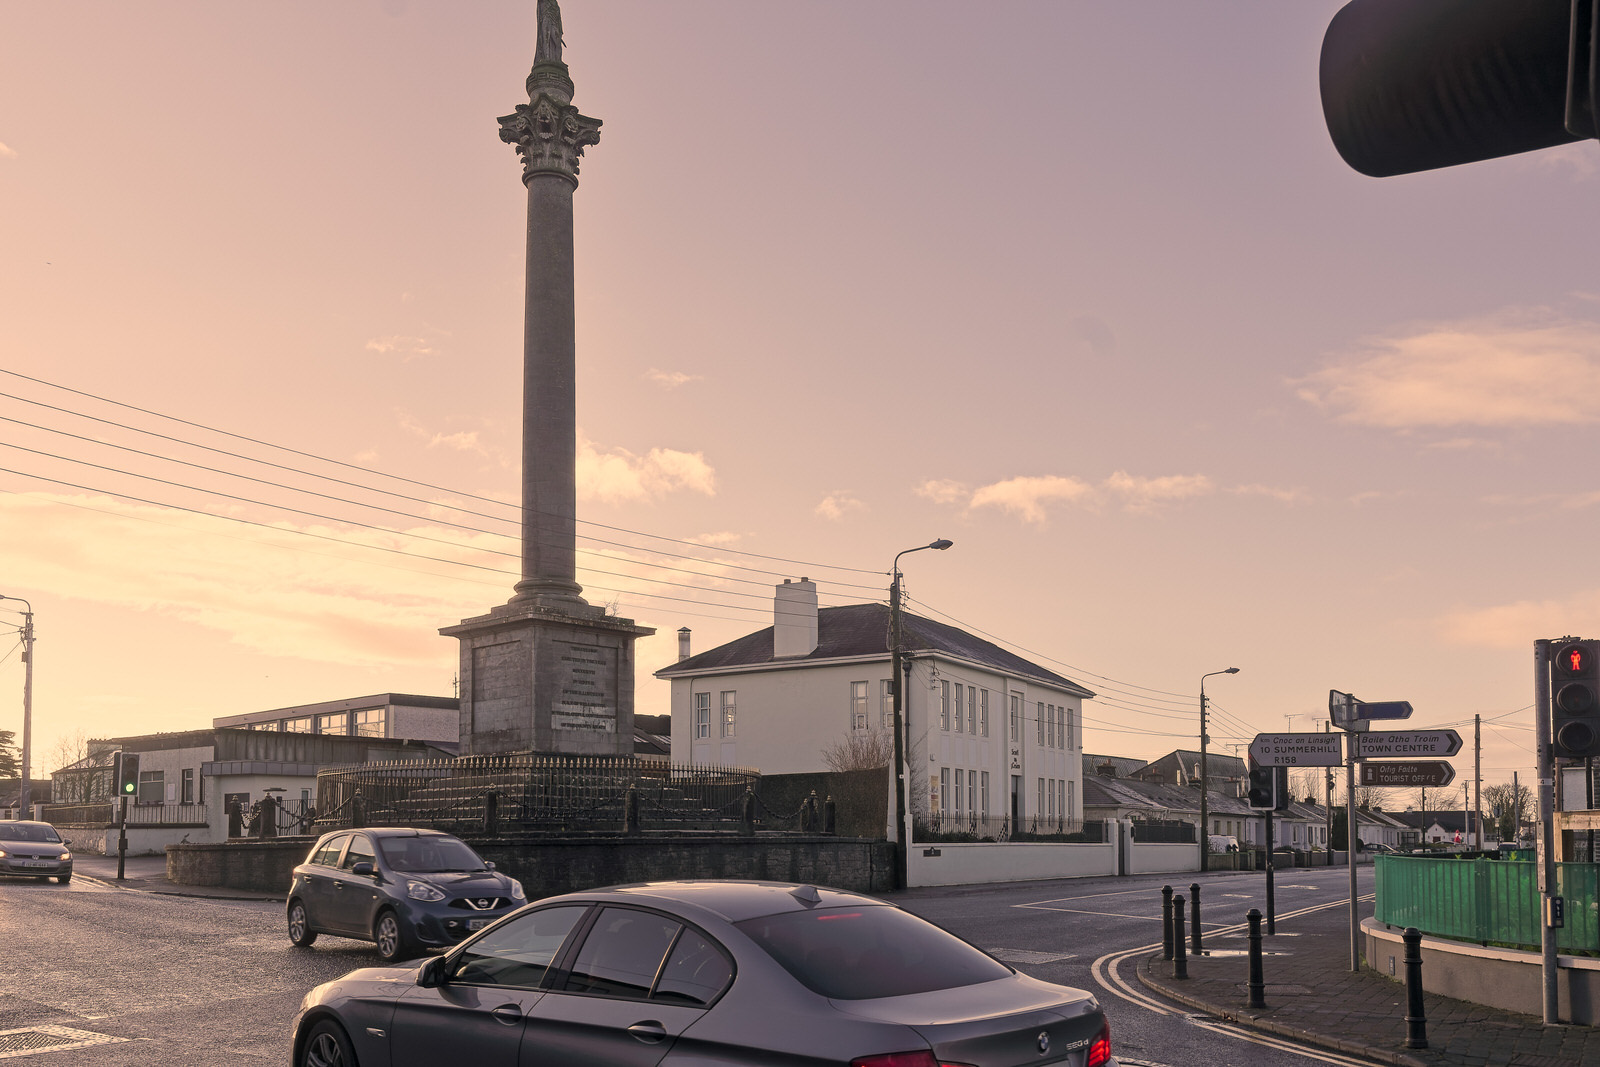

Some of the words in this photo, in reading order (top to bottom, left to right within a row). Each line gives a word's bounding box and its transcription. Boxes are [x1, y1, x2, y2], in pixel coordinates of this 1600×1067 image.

[1308, 737, 1336, 745] Linsigh
[1414, 735, 1440, 743] Troim
[1395, 744, 1436, 752] CENTRE
[1274, 756, 1297, 764] R158
